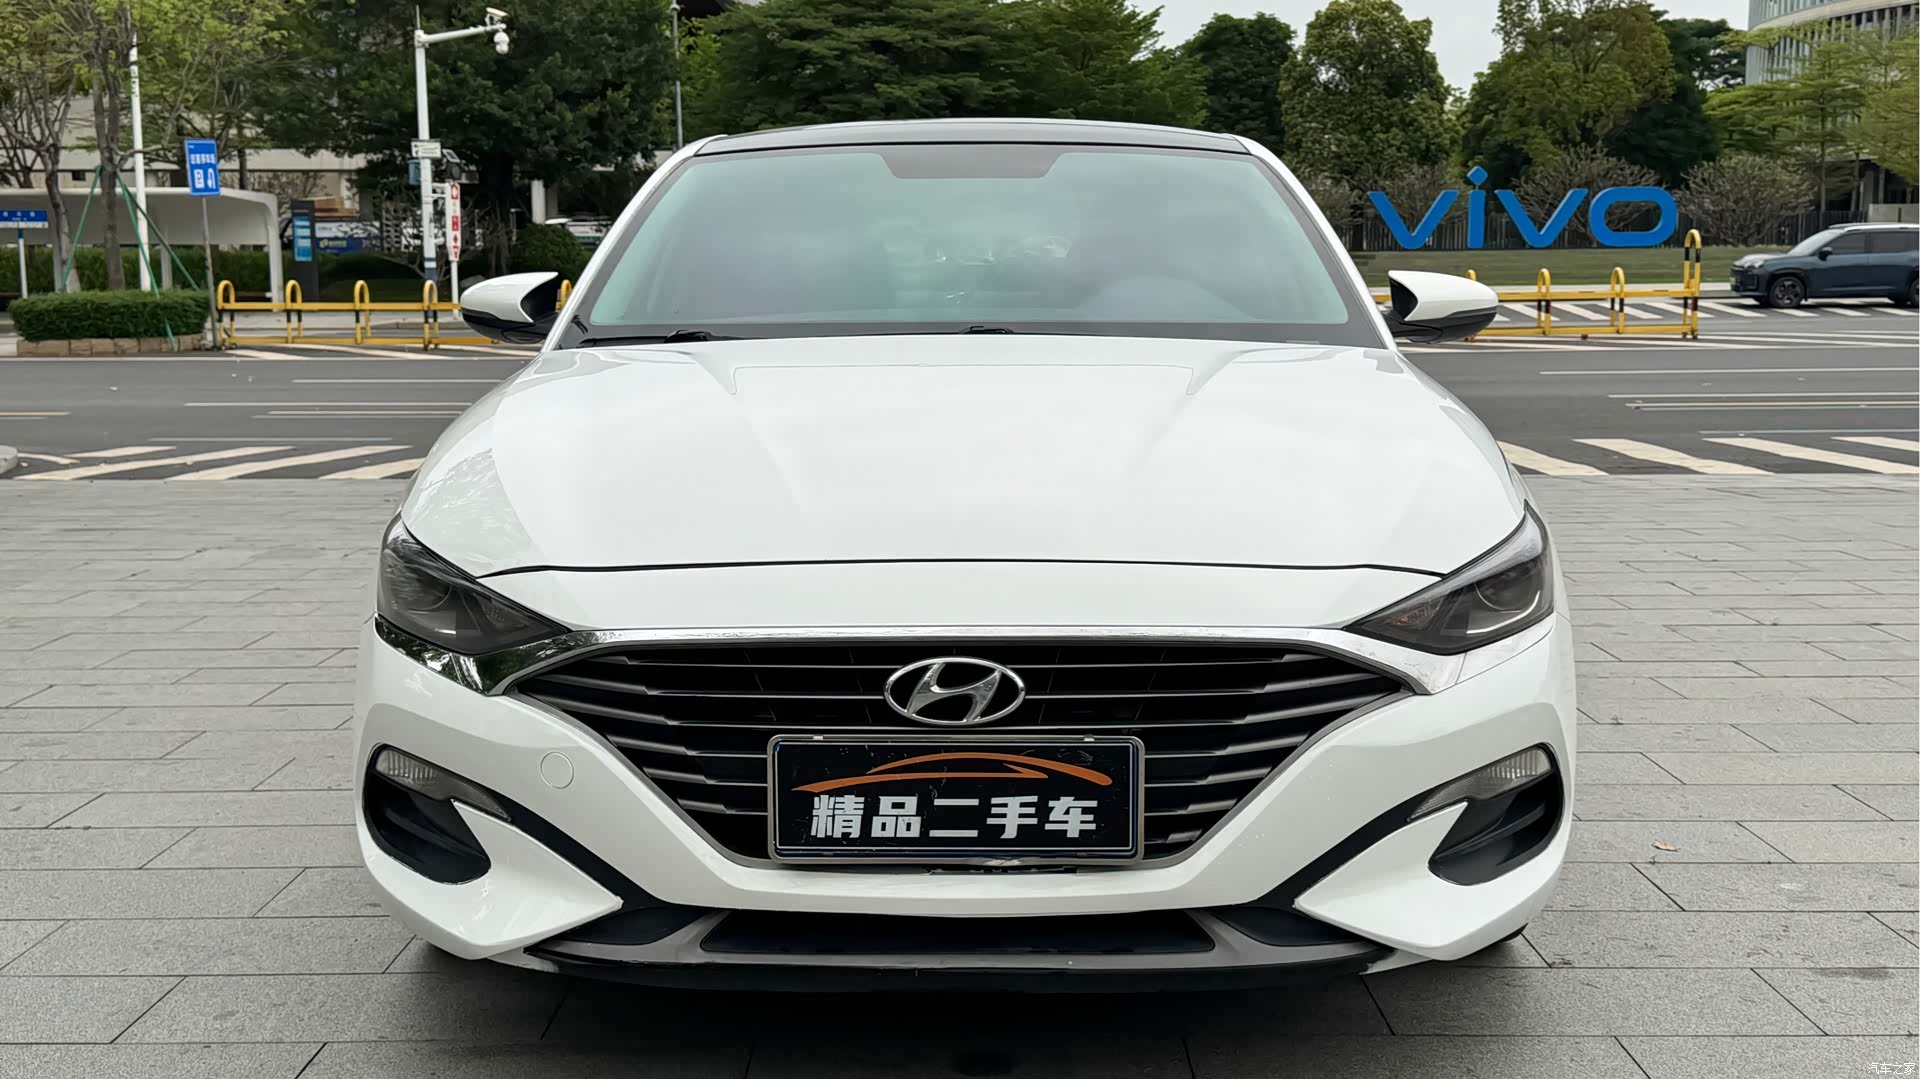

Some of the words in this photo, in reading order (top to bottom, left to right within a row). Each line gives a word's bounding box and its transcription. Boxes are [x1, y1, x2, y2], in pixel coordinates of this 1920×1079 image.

[1368, 166, 1678, 249] vivo
[810, 794, 1098, 839] 精品二手车
